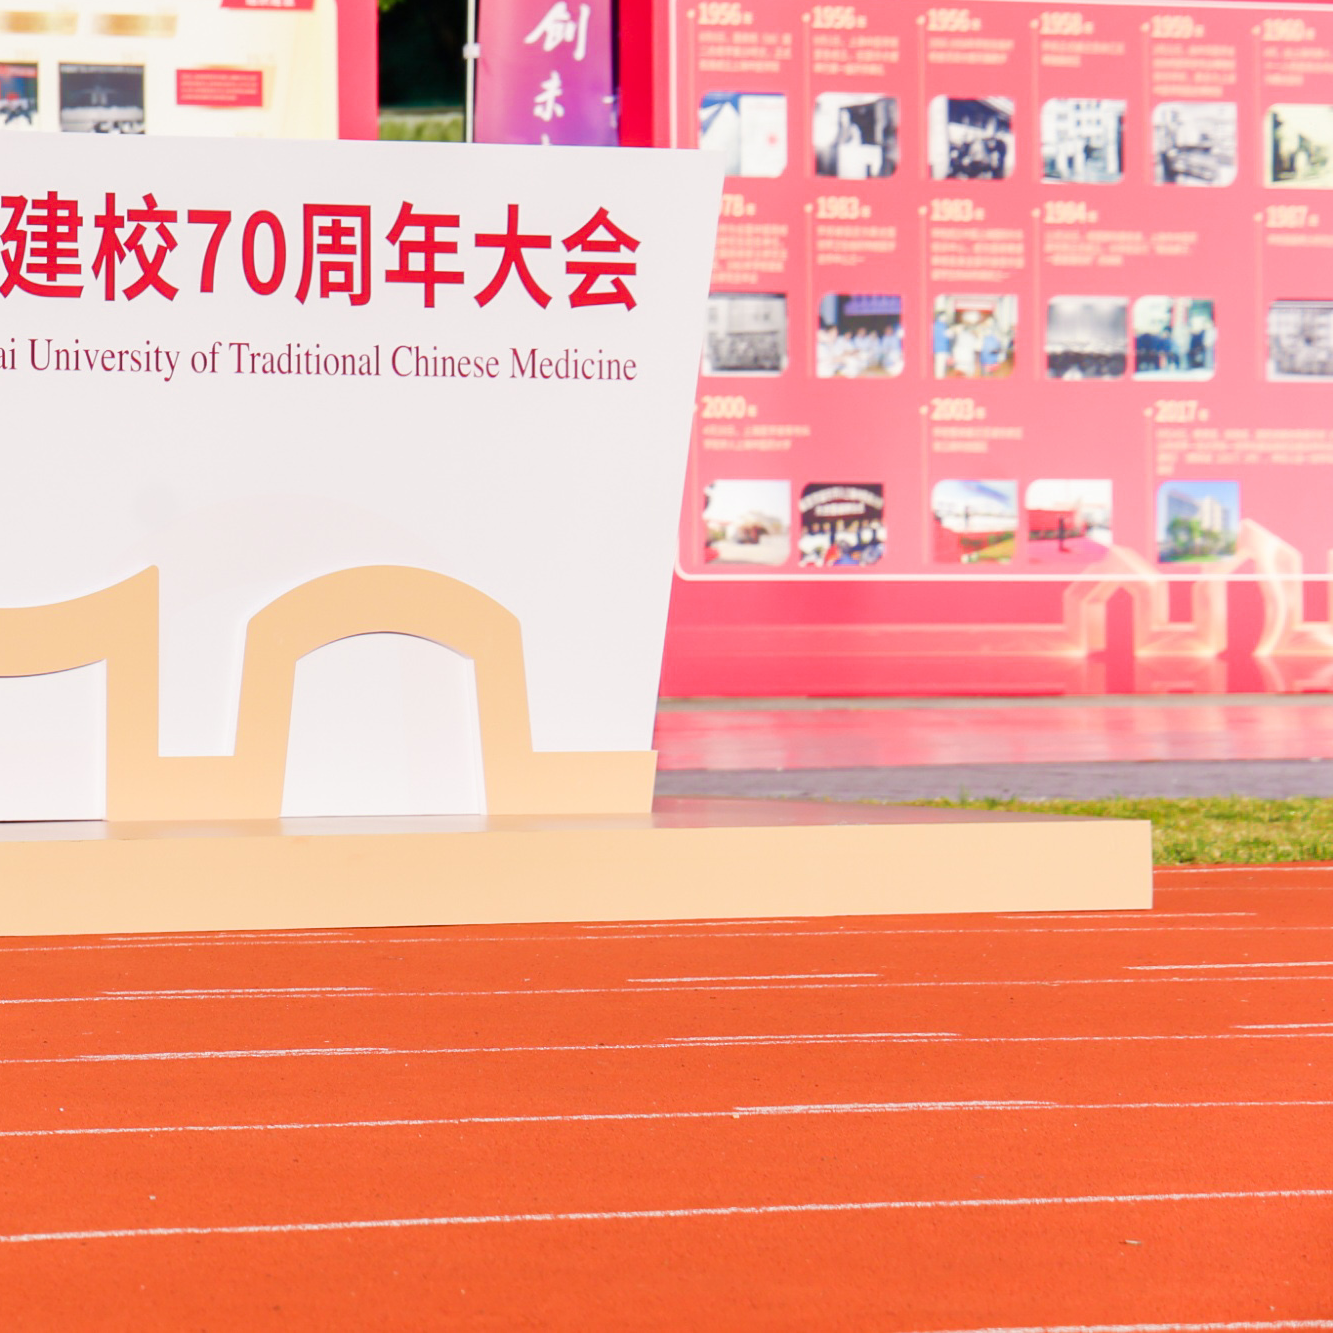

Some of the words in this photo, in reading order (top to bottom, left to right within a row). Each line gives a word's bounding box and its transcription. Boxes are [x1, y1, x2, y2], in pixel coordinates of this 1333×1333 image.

[28, 338, 181, 383] University
[190, 341, 223, 375] of
[229, 342, 382, 378] Traditional
[391, 345, 500, 379] Chinese
[509, 347, 638, 382] Medicine
